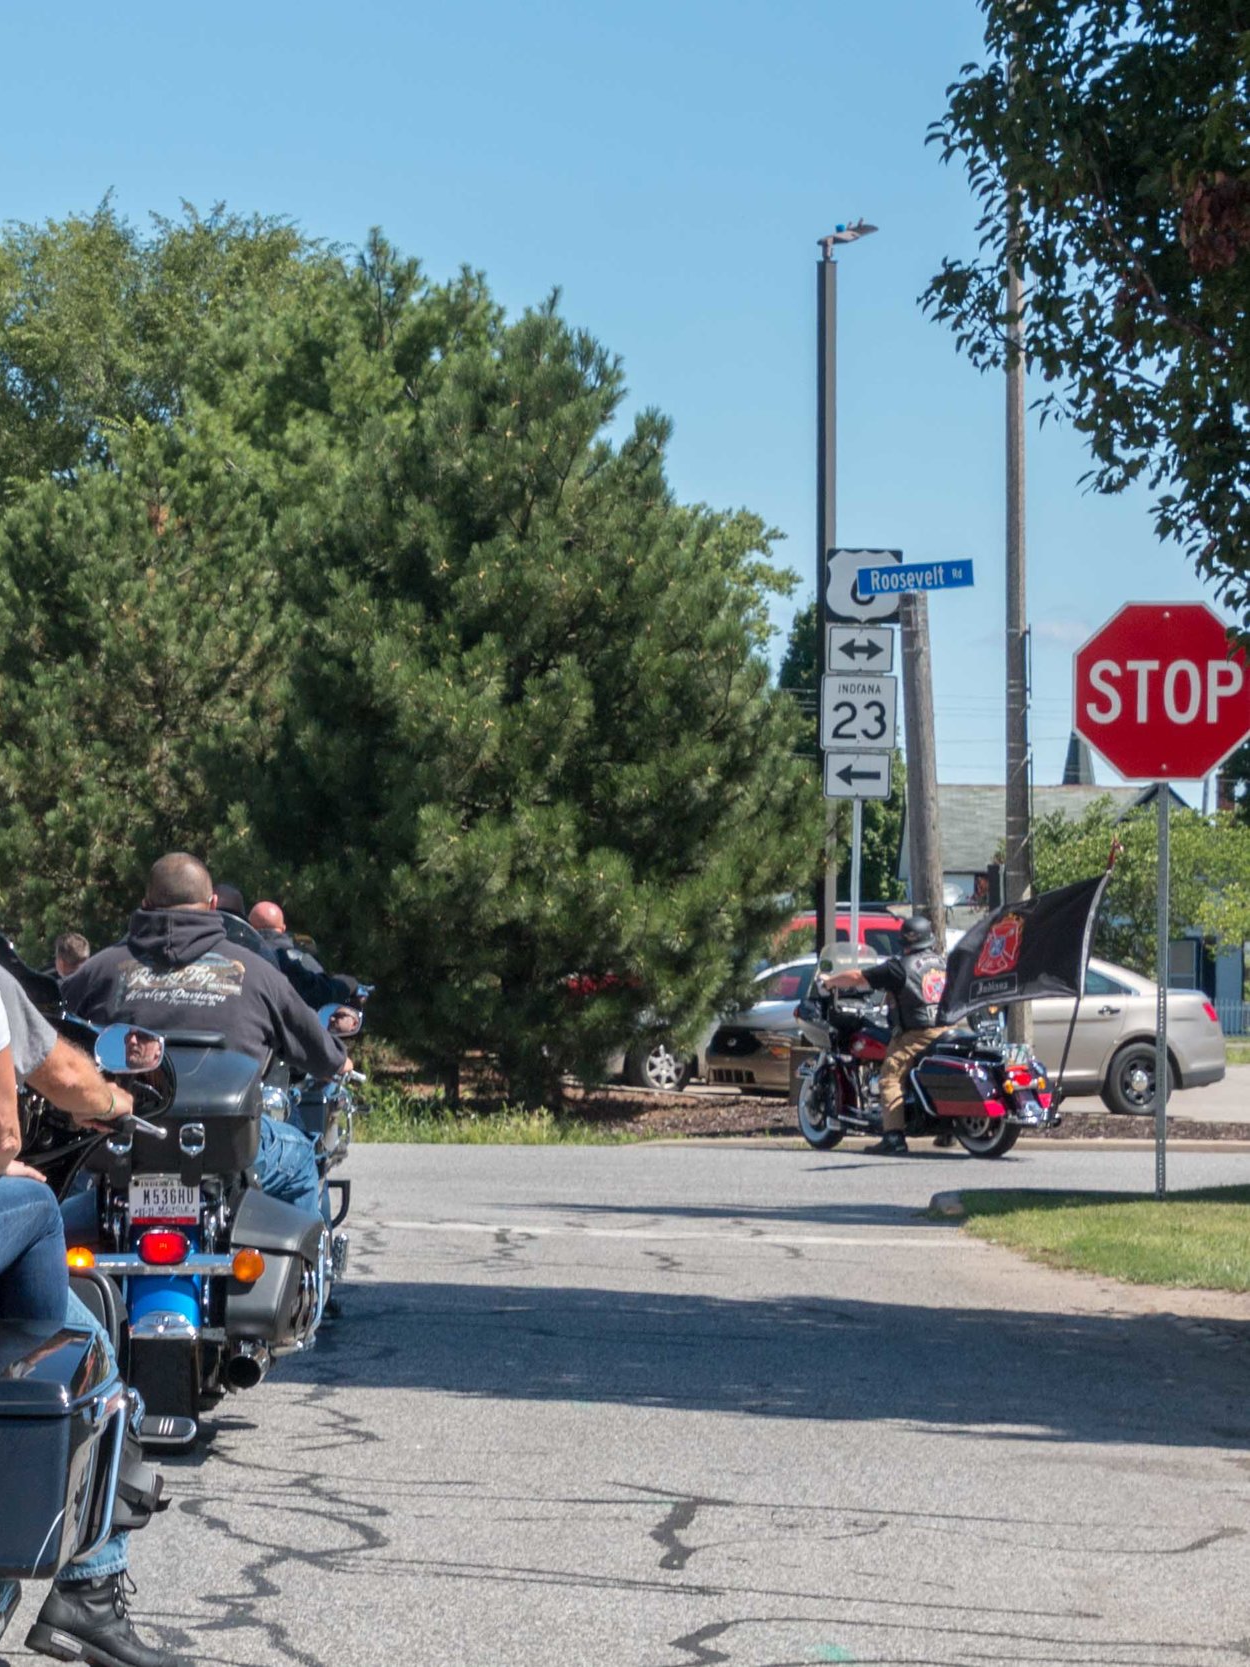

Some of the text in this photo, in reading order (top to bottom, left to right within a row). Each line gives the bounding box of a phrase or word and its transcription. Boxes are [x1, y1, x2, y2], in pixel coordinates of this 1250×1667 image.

[870, 565, 963, 591] Roosevelt Rd
[837, 682, 882, 694] INDIANA
[1086, 659, 1244, 725] STOP
[831, 700, 887, 741] 23
[184, 964, 218, 987] Top
[143, 1188, 194, 1206] M536HU
